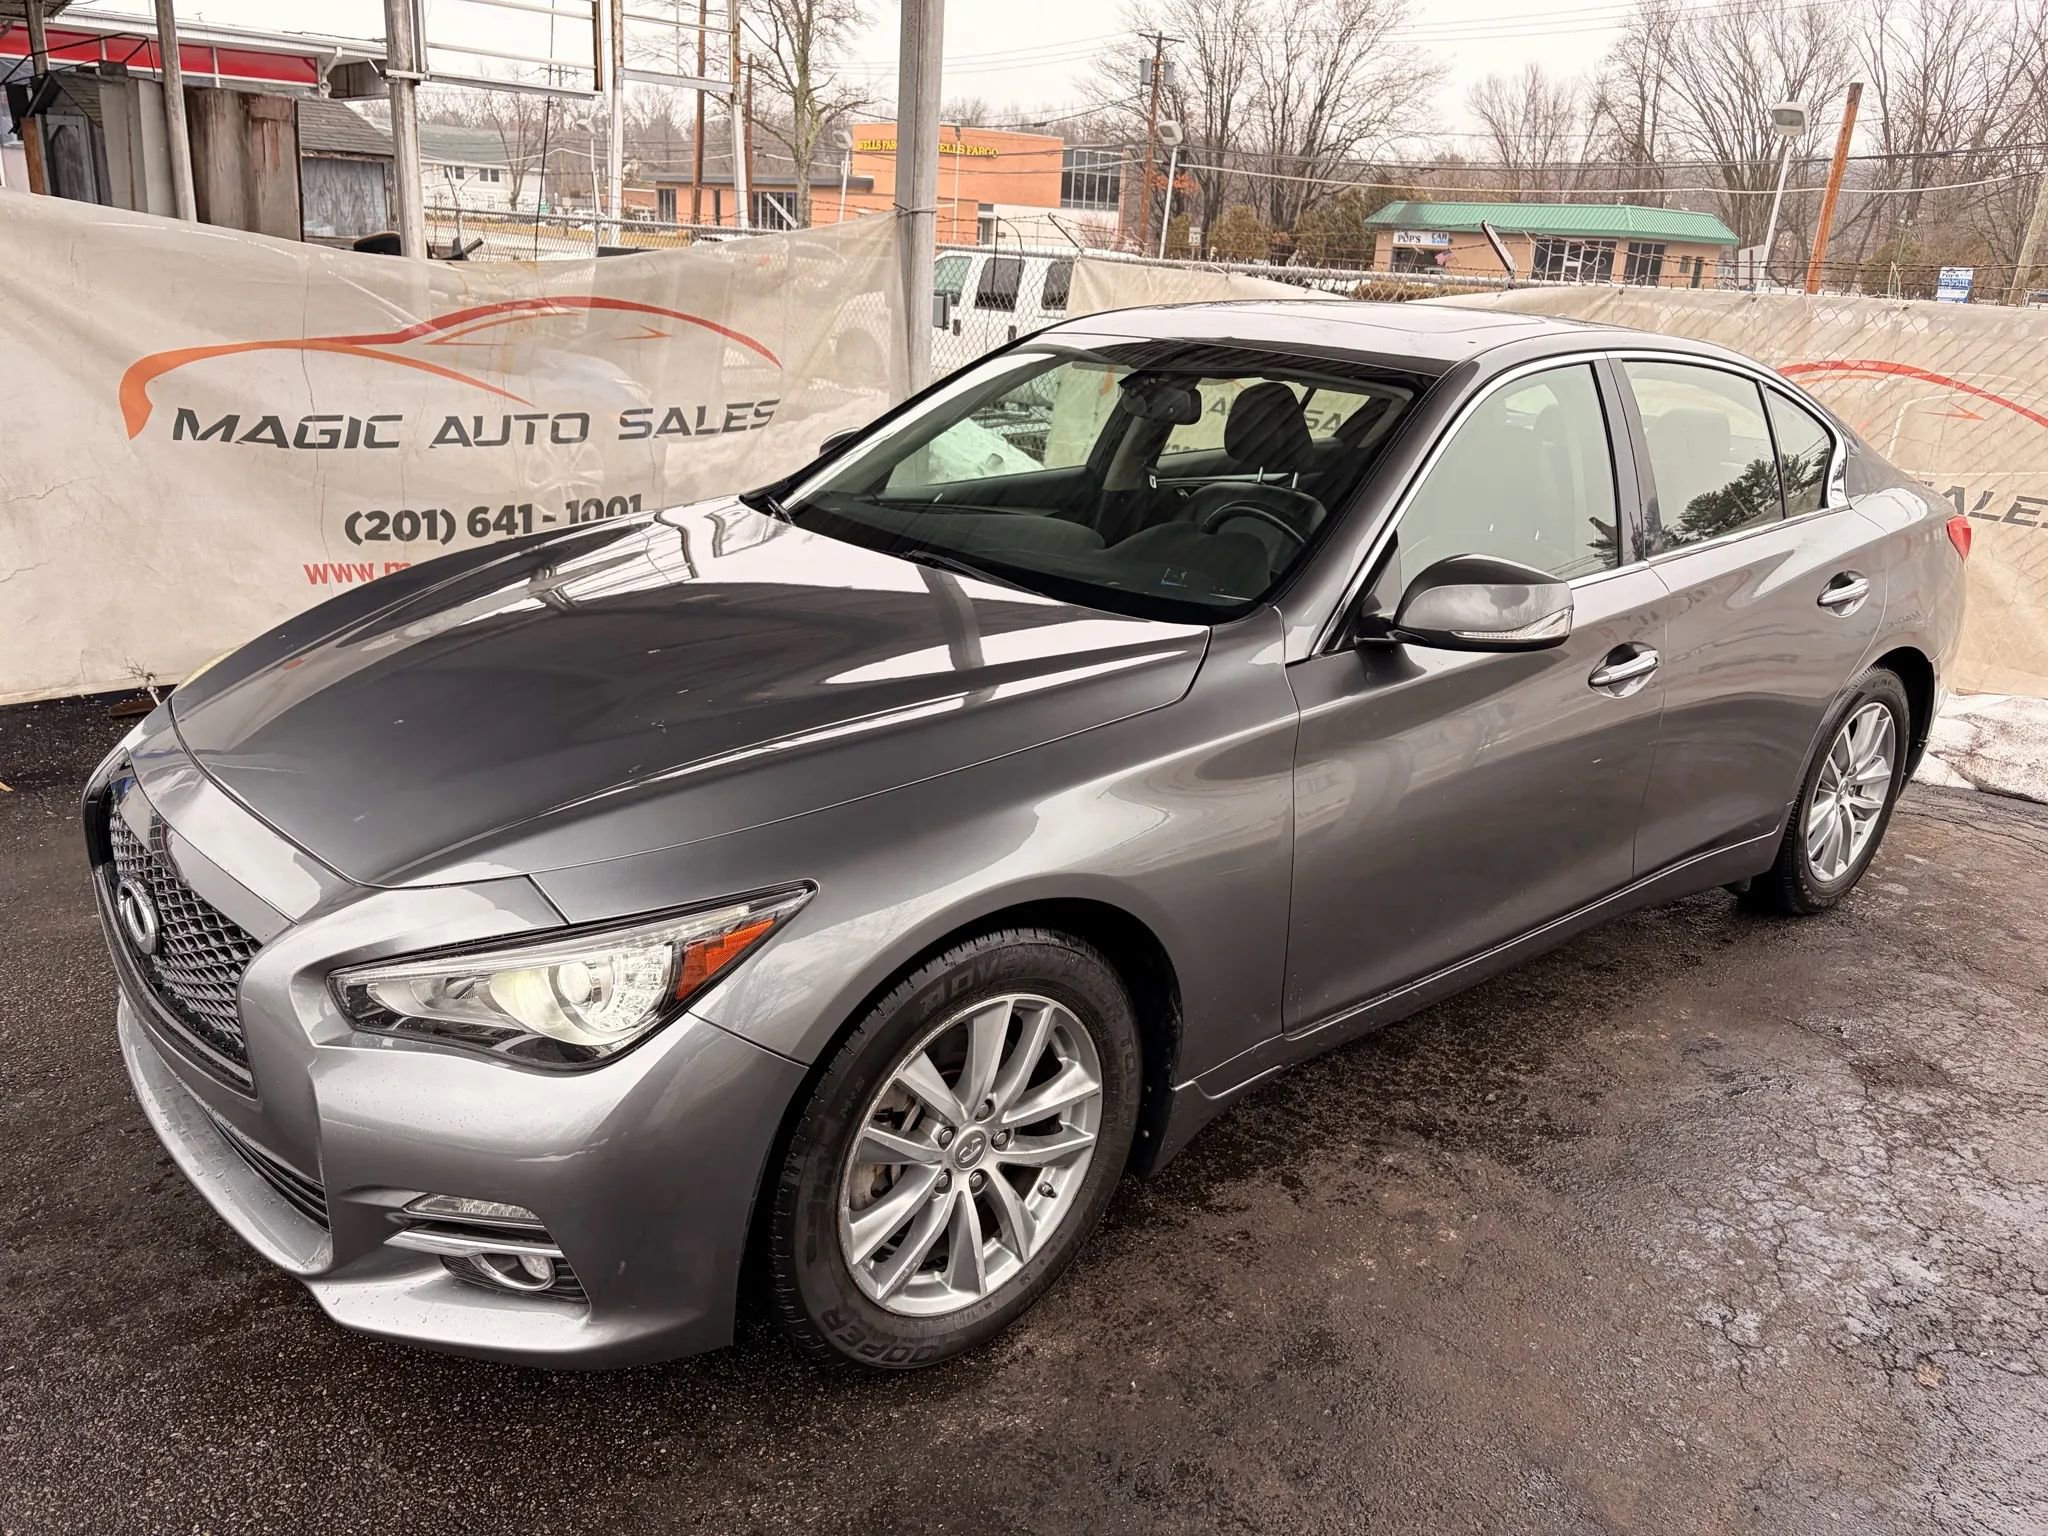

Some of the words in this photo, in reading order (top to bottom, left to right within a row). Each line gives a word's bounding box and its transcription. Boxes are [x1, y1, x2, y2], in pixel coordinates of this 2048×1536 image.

[858, 139, 882, 150] WELLS
[882, 140, 897, 150] FAR
[939, 143, 965, 154] ELLS
[966, 145, 999, 158] FARGO
[1432, 232, 1447, 240] CAR
[172, 407, 403, 449] MAGIC
[429, 412, 590, 449] AUTO
[618, 399, 781, 440] SALES
[344, 508, 456, 546] (201)
[467, 503, 533, 538] 641
[565, 493, 642, 525] 1001
[1919, 479, 2048, 529] ALE
